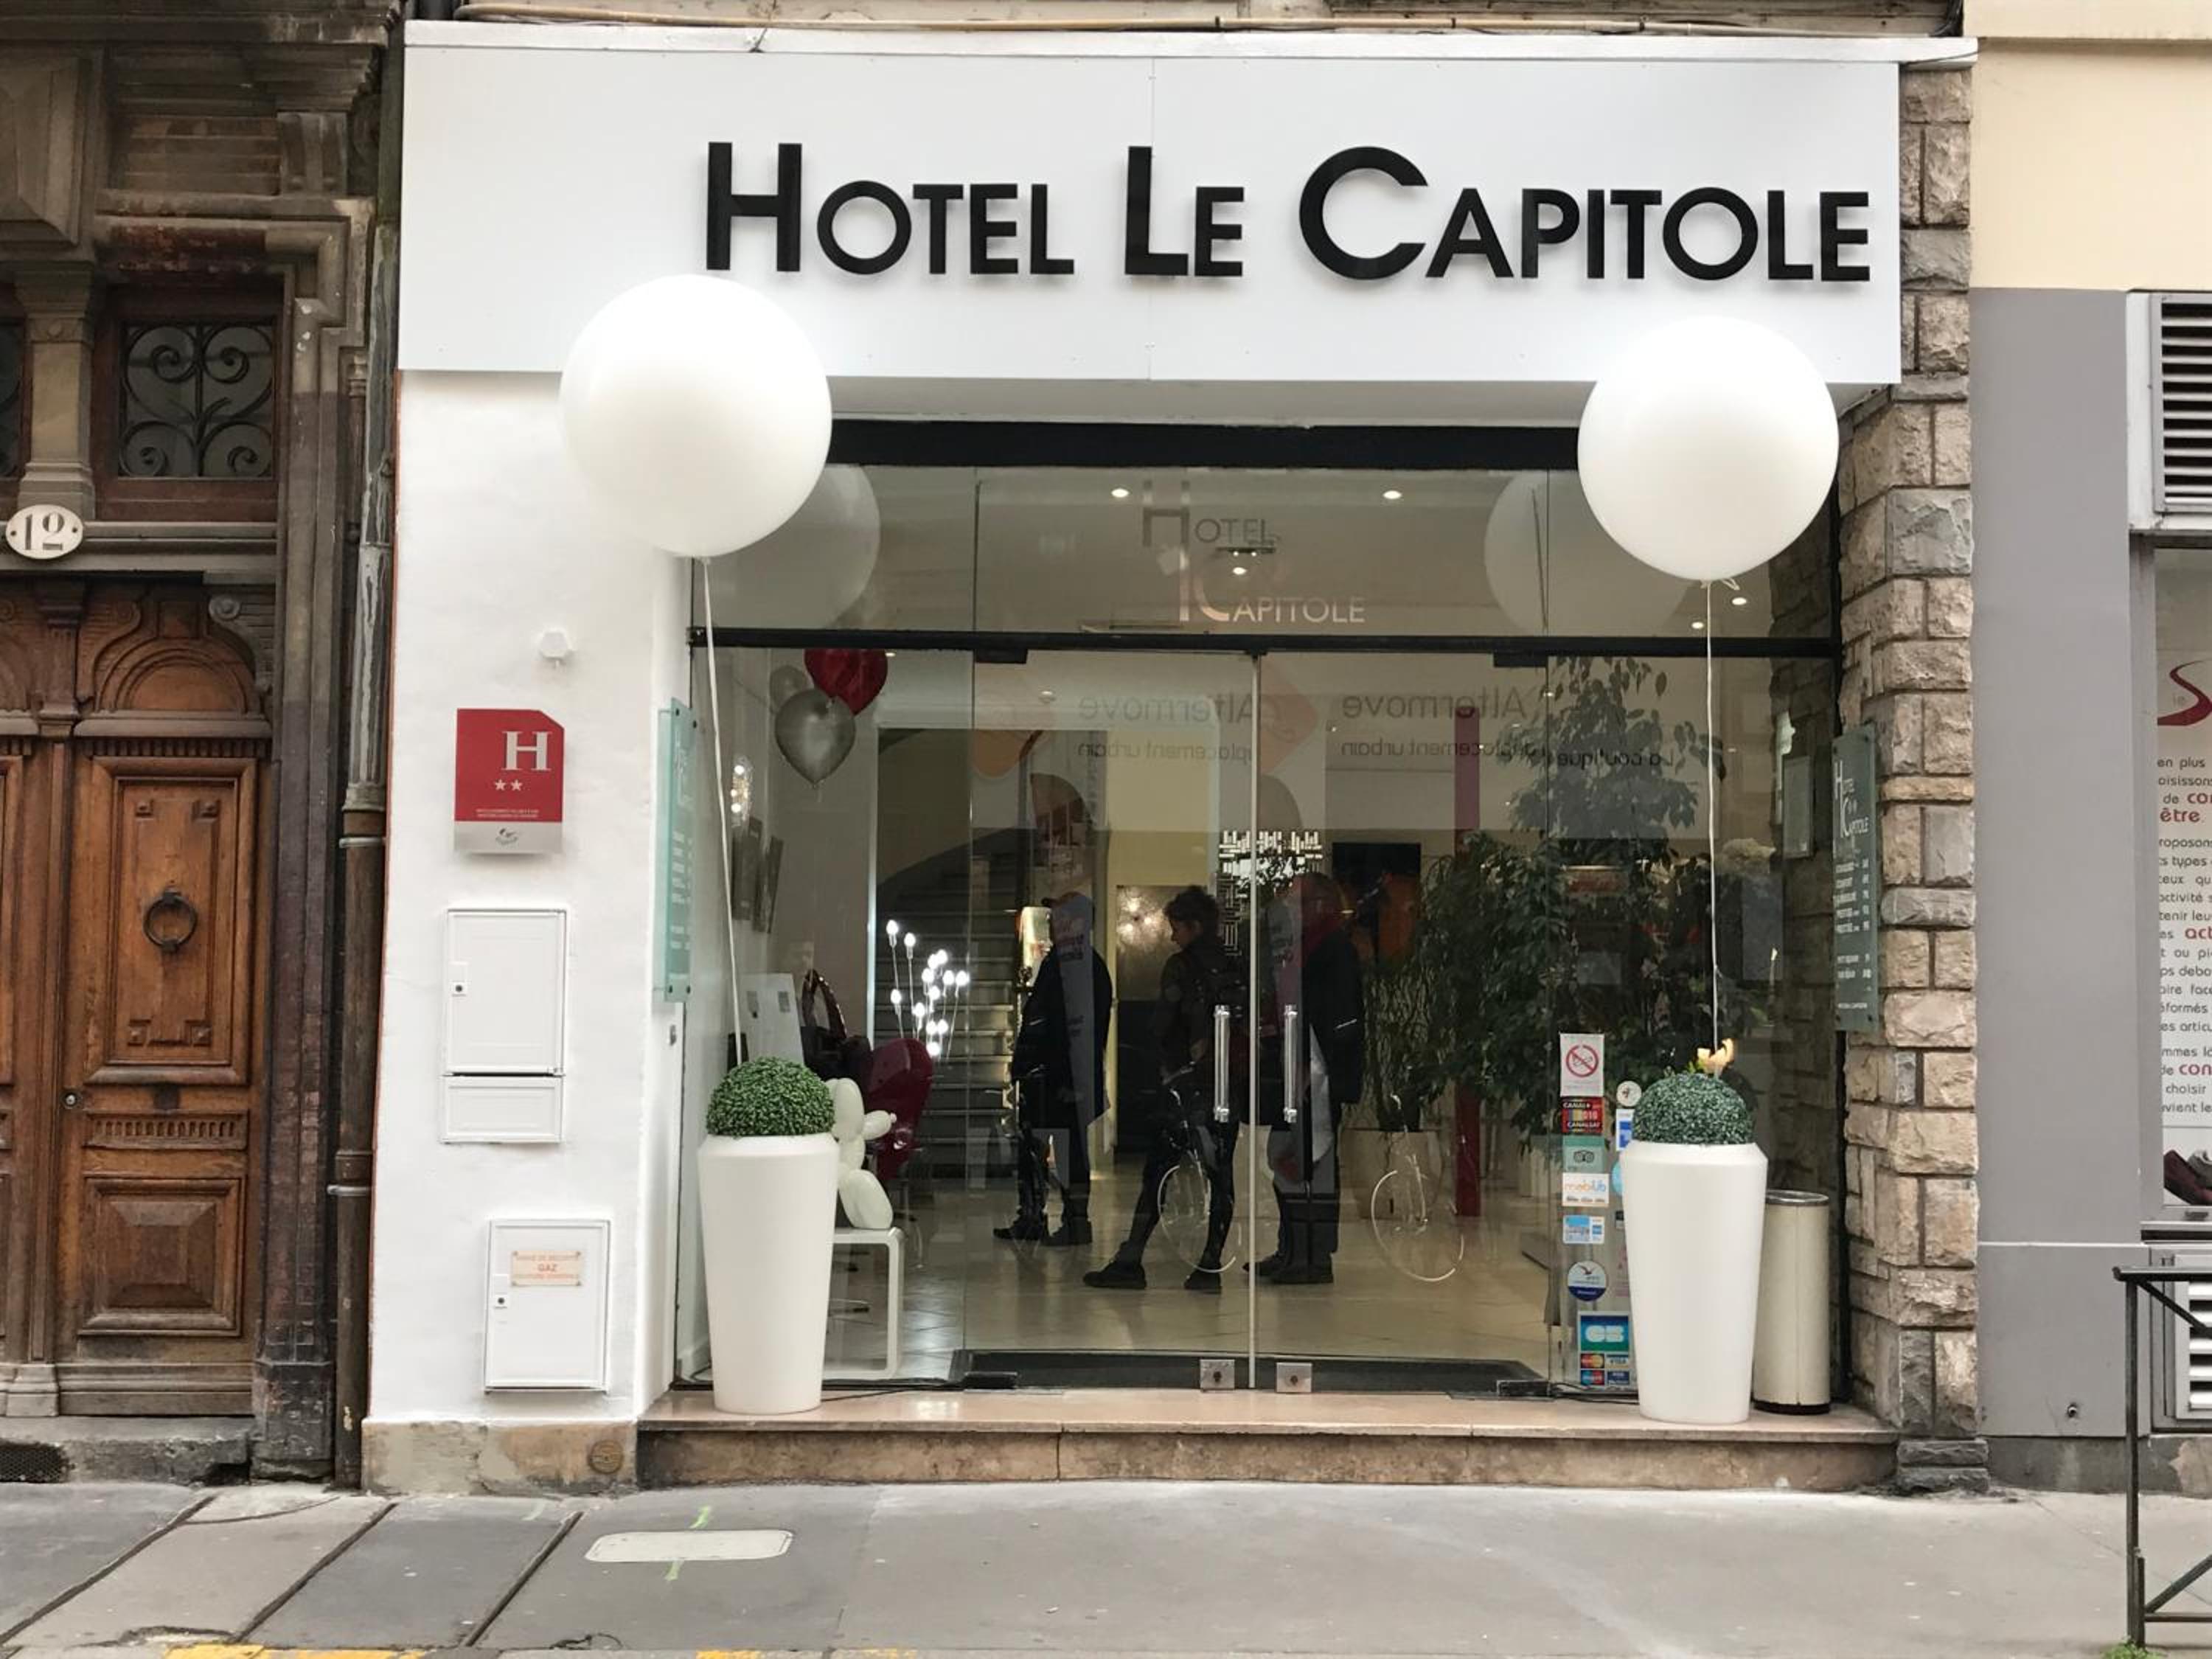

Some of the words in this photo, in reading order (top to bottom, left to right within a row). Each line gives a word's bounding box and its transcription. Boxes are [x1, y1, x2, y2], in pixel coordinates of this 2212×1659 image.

[706, 141, 1075, 275] HOTEL
[1124, 145, 1245, 277] LE
[1299, 145, 1871, 283] CAPITOLE
[25, 513, 64, 551] 12
[501, 731, 552, 771] H
[2180, 757, 2205, 770] plus
[2163, 793, 2179, 804] de
[2187, 793, 2212, 804] co
[2172, 855, 2207, 869] types
[2174, 949, 2189, 958] ou
[2198, 948, 2212, 961] pi
[2166, 1082, 2206, 1094] choisir
